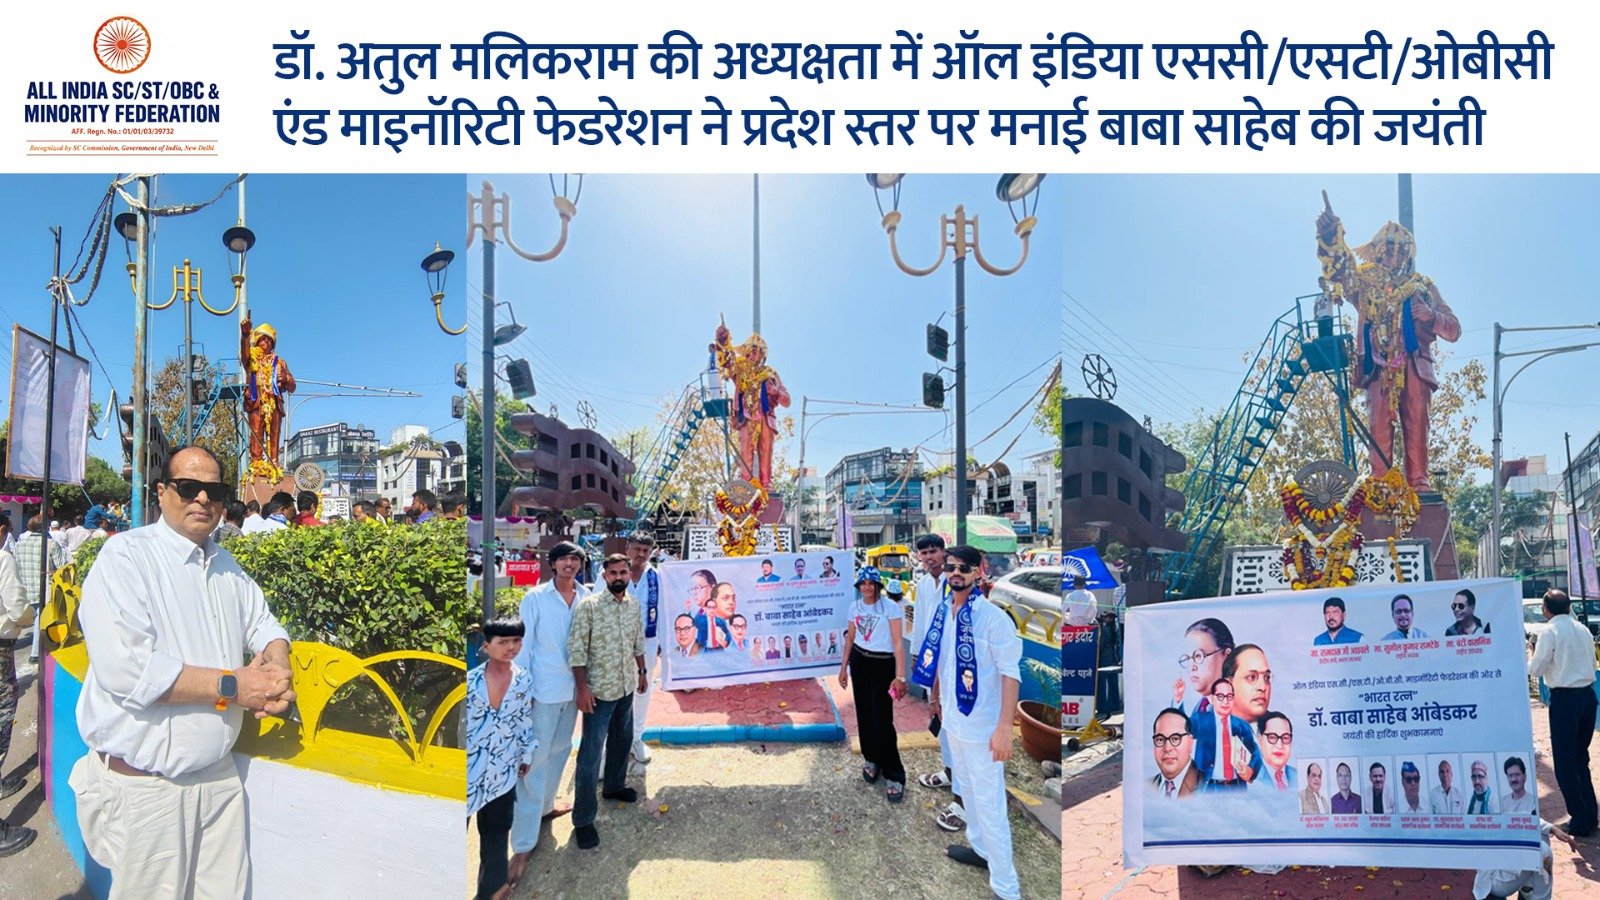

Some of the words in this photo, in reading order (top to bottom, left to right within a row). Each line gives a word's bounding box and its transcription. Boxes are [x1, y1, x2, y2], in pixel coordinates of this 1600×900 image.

[1074, 628, 1094, 643] इंदौर
[1402, 642, 1419, 654] कुमार
[1308, 680, 1326, 689] इंडिया
[1405, 672, 1439, 683] माइनॉरिटी
[1440, 671, 1468, 681] फेडरेशन
[1469, 670, 1479, 679] की
[1480, 669, 1494, 679] ओर
[1495, 668, 1502, 679] से
[1308, 707, 1328, 727] डॉ.
[1330, 709, 1364, 725] बाबा
[1366, 704, 1407, 725] साहेब
[1411, 701, 1477, 722] आंबेडकर
[1342, 729, 1363, 740] जयंती
[1364, 729, 1375, 740] की
[1377, 728, 1399, 739] हार्दिक
